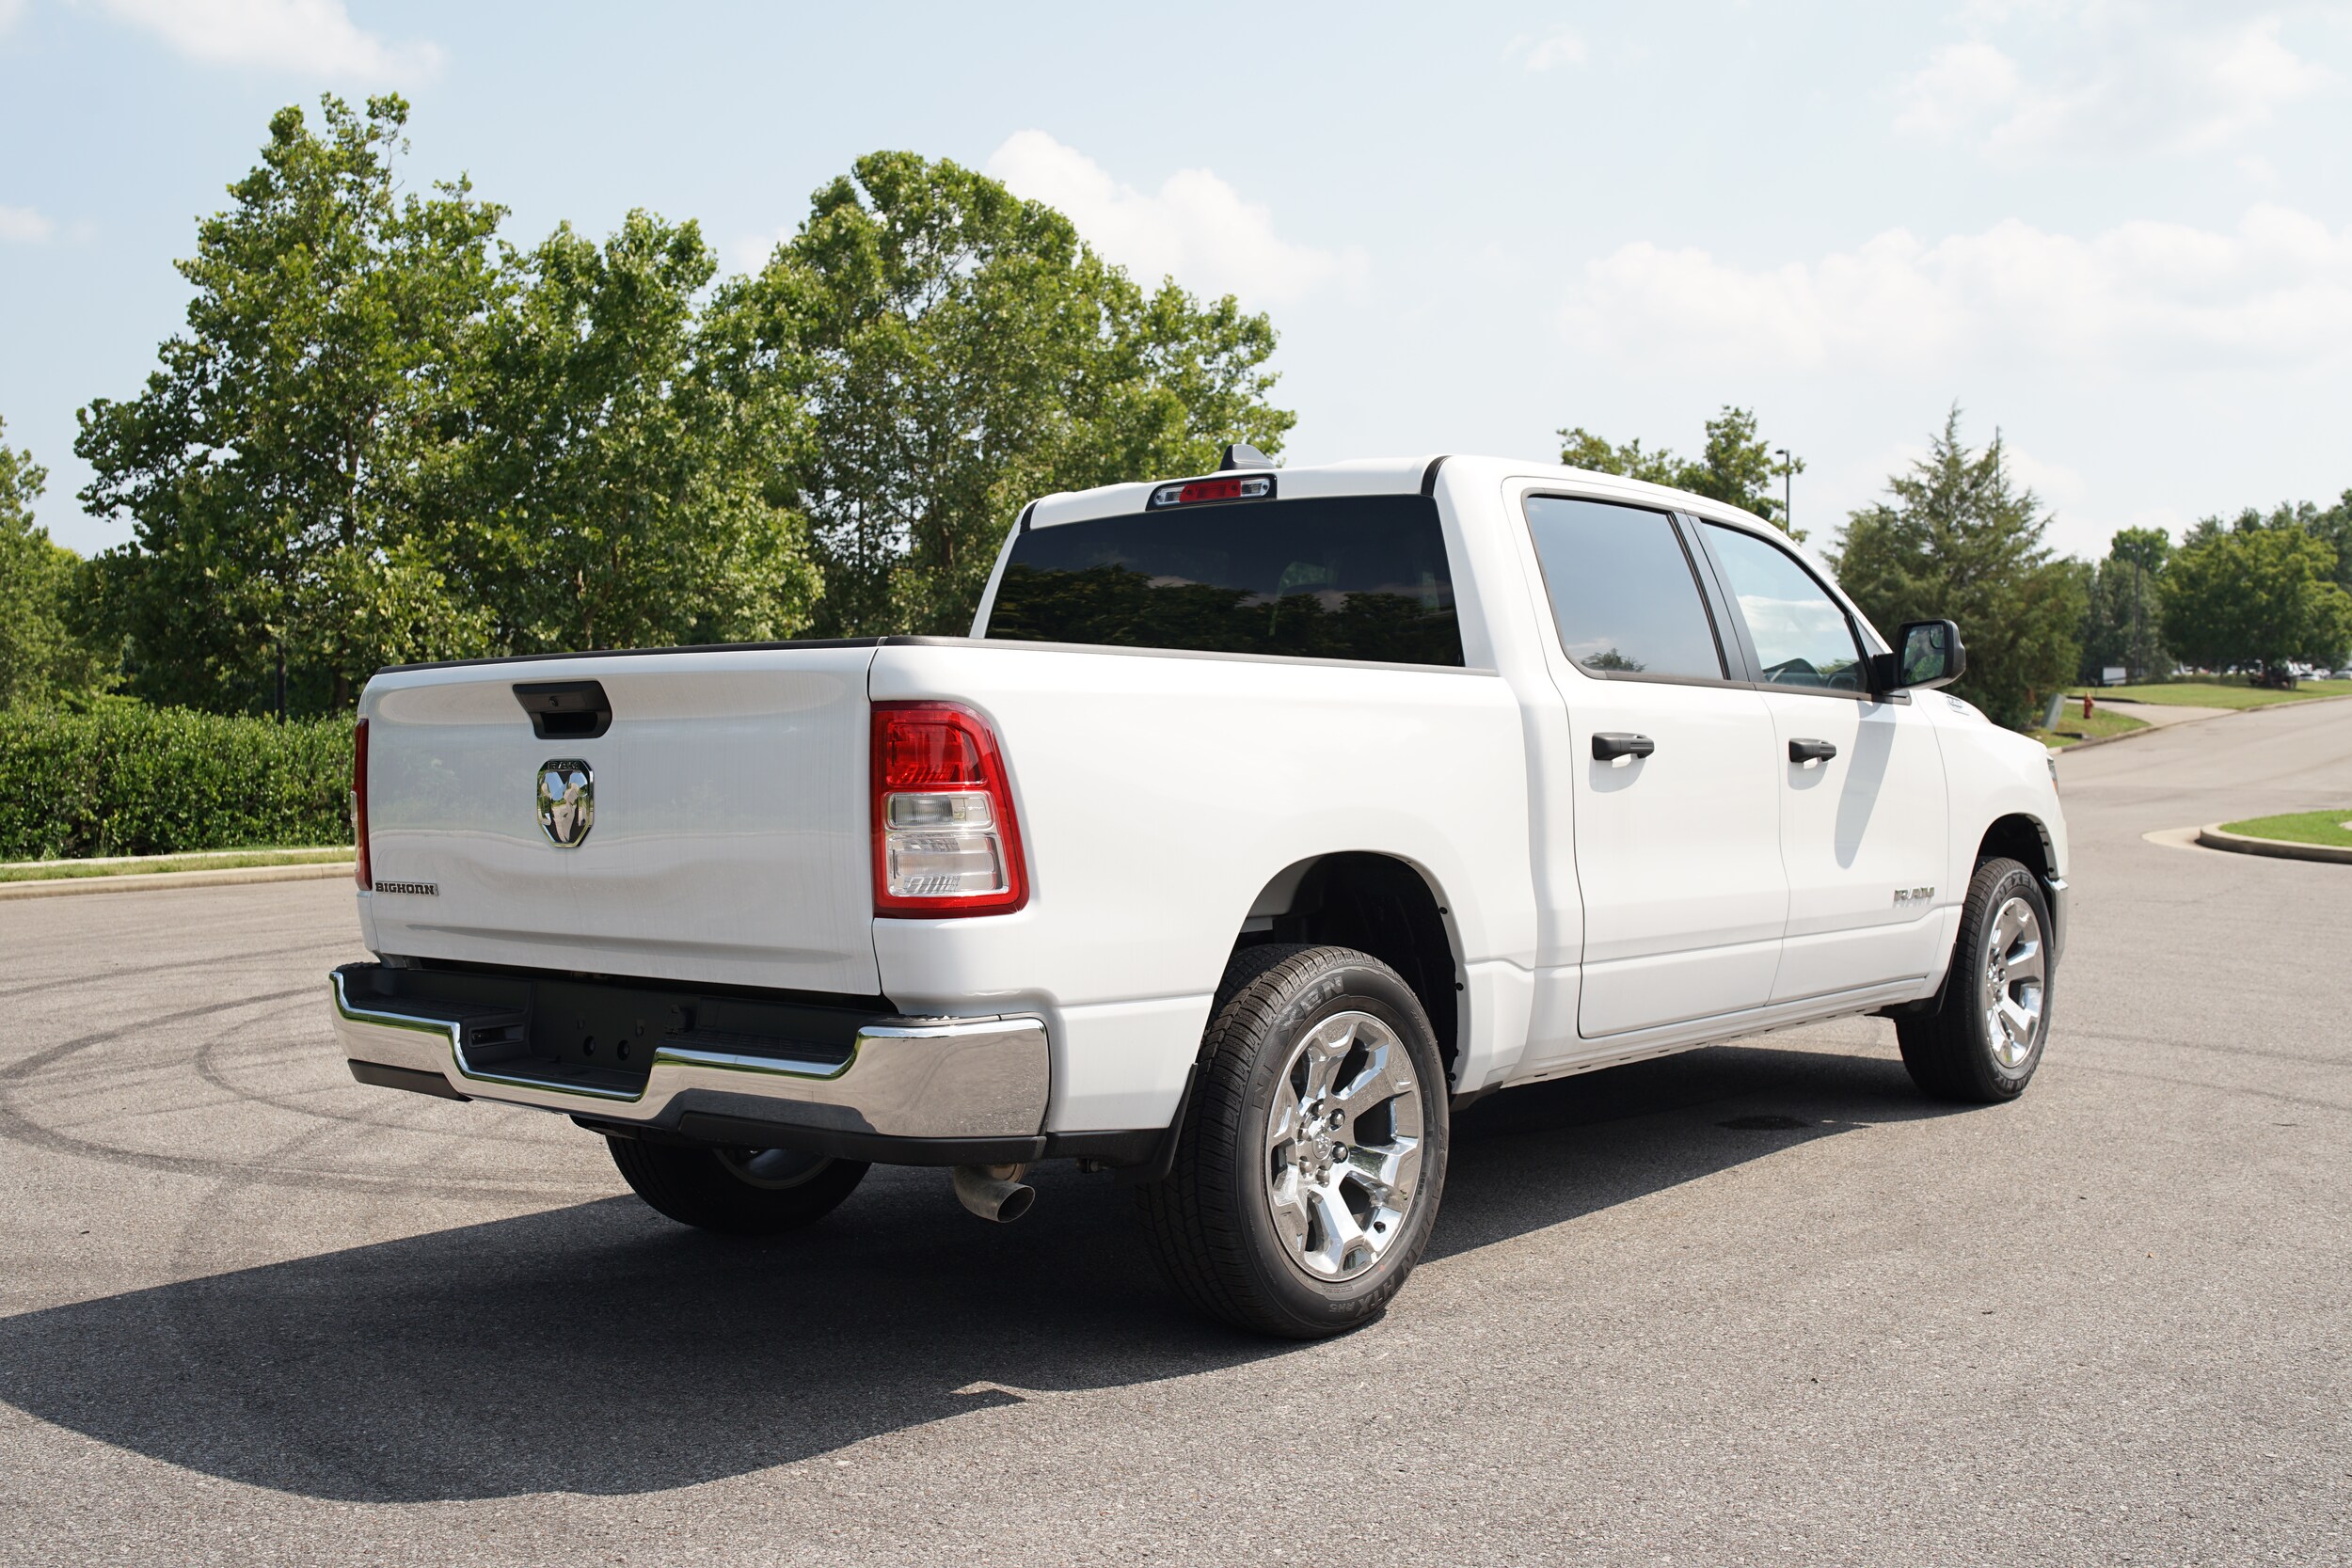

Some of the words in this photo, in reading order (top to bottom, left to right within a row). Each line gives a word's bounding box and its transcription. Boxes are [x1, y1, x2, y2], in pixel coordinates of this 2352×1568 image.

[547, 761, 580, 769] RAM
[375, 882, 435, 895] BIGHORN
[1894, 887, 1934, 902] RAM
[1995, 872, 2038, 904] NEXEN
[1356, 1275, 1396, 1317] HTX
